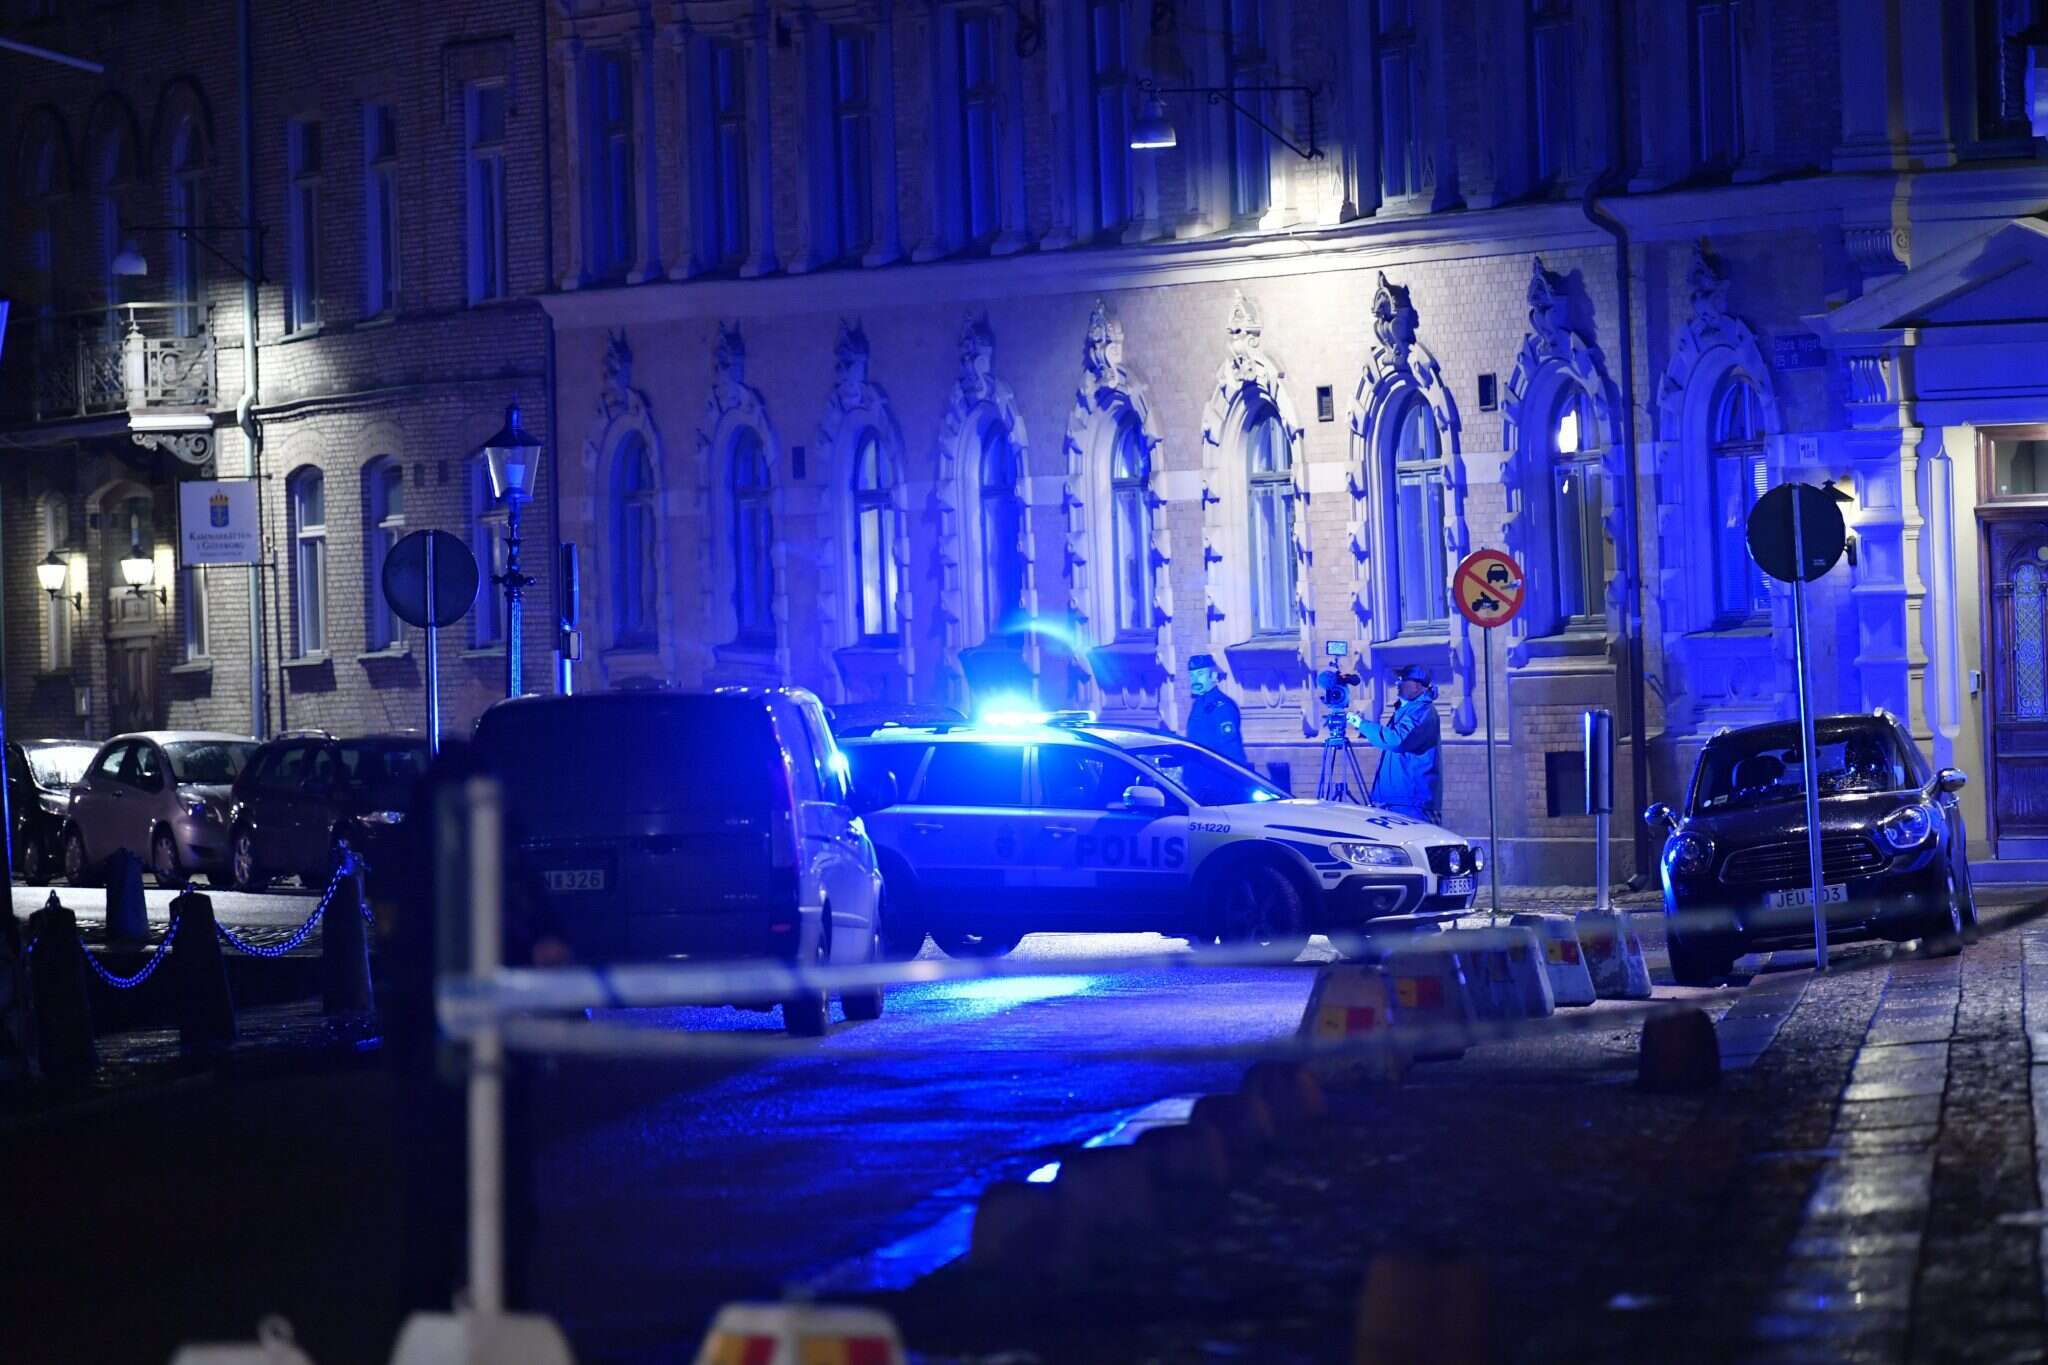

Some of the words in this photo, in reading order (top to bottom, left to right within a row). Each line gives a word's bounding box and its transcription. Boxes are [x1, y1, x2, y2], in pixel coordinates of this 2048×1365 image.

[1189, 822, 1231, 834] 51-1220
[1076, 834, 1185, 869] POLIS
[567, 871, 601, 889] 326
[1776, 890, 1806, 909] JEU
[1809, 886, 1841, 905] 03
